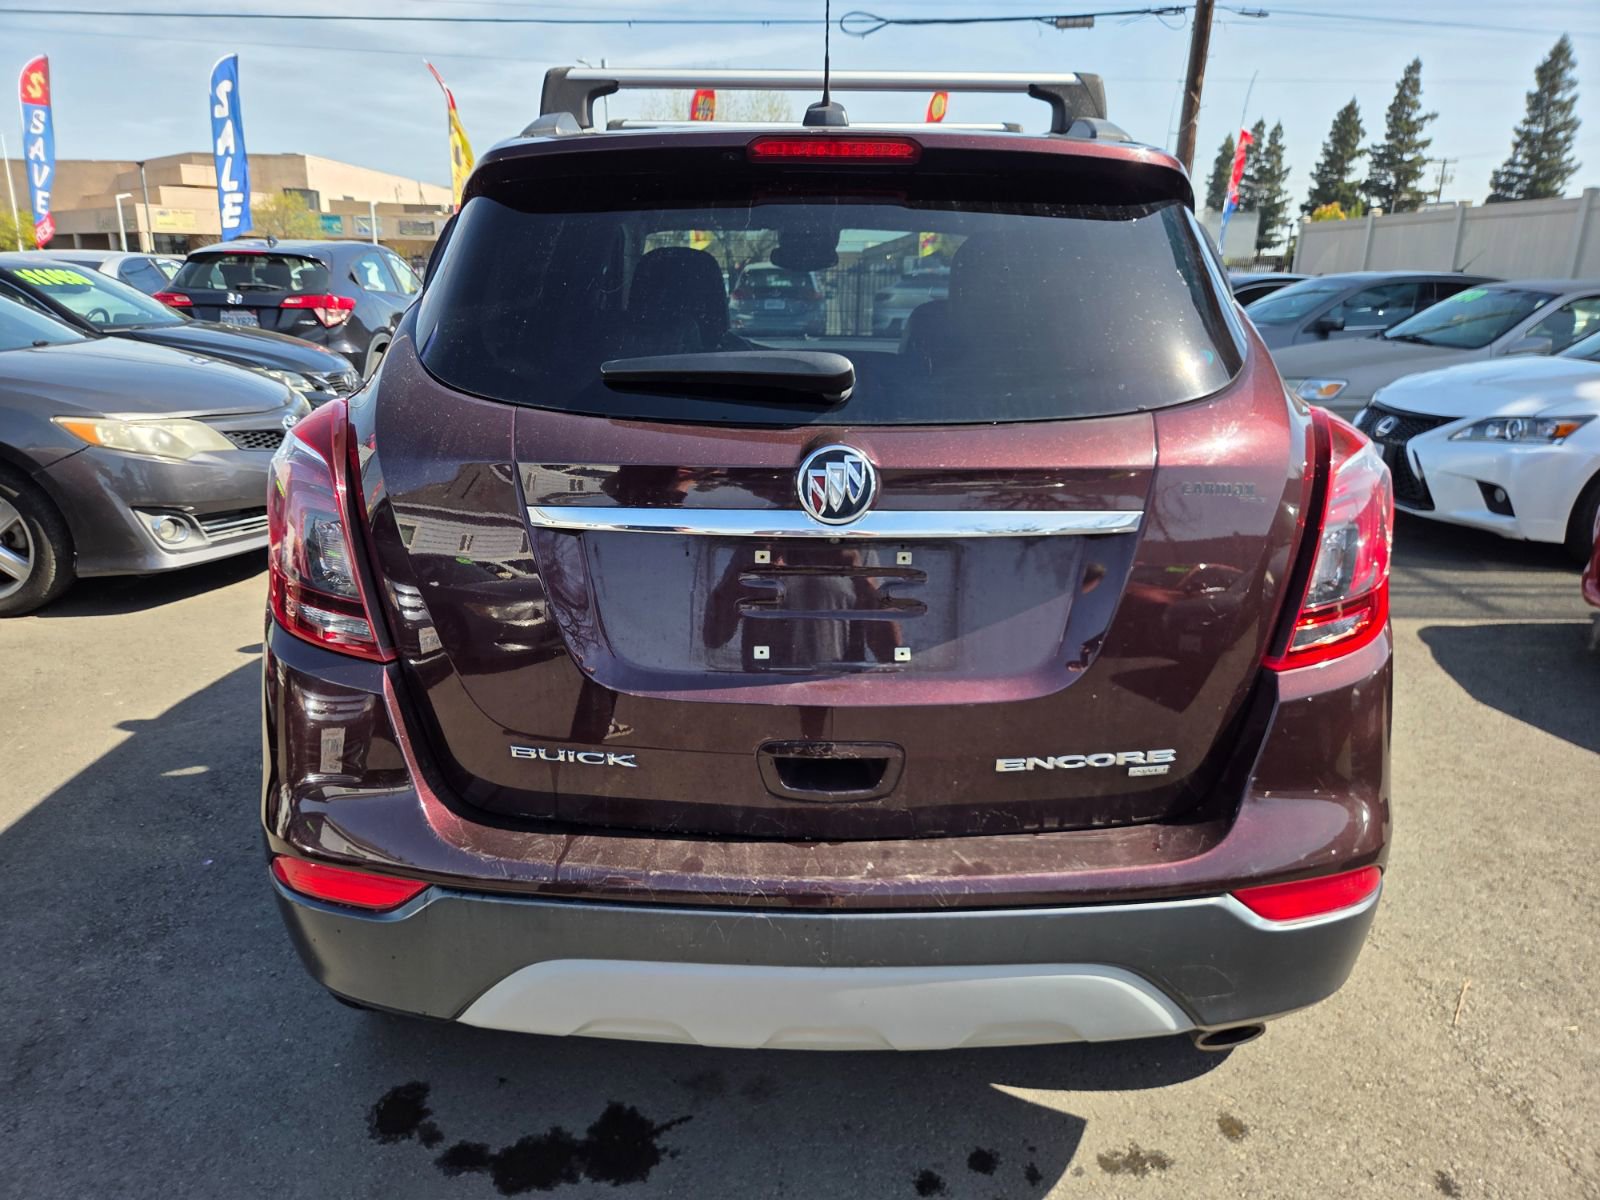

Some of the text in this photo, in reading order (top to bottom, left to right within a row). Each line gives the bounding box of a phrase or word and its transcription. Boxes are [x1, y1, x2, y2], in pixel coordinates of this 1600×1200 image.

[29, 109, 50, 216] SAVE
[214, 79, 244, 229] SALE
[510, 745, 638, 768] BUICK
[995, 748, 1176, 772] ENCORE
